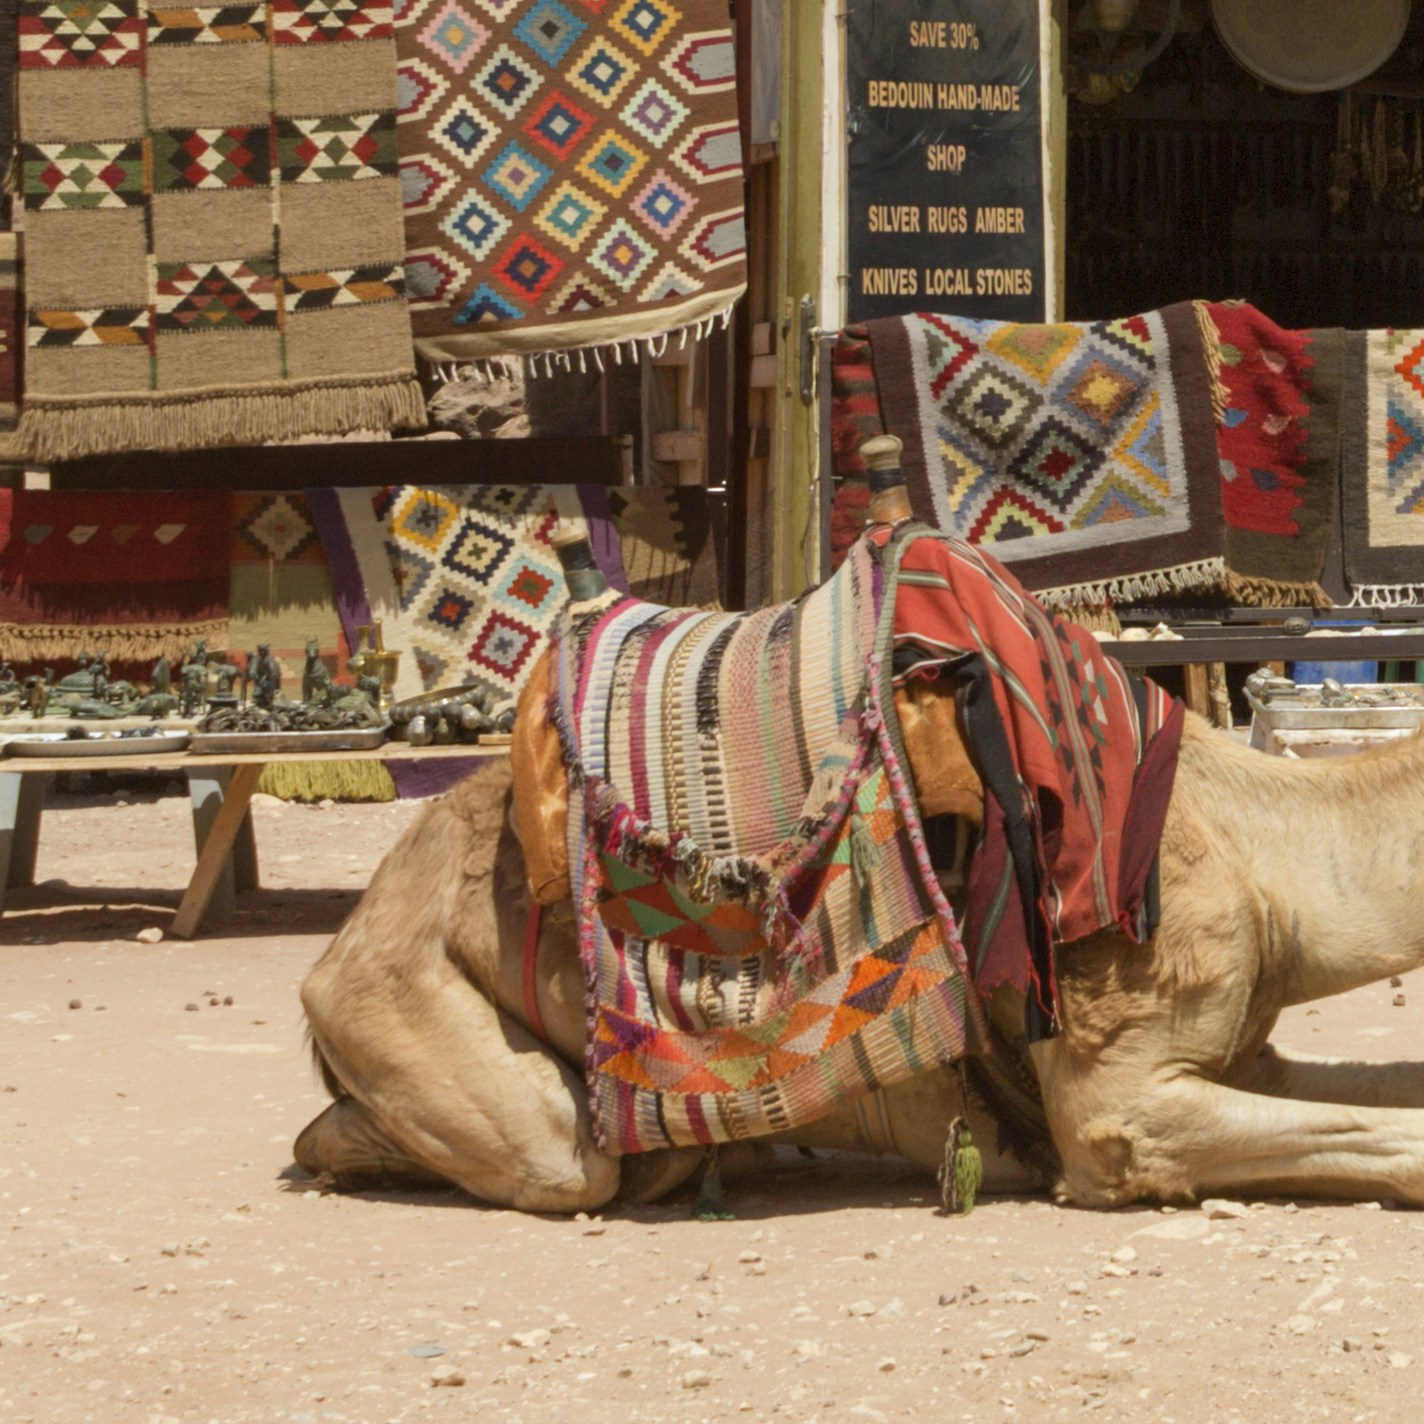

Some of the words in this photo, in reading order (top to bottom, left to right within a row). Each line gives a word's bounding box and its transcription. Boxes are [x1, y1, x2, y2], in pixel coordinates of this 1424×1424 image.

[910, 21, 946, 48] SAVE
[950, 23, 979, 51] 30%
[868, 80, 933, 109] BEDOUIN
[937, 83, 1020, 111] HAND-MADE
[927, 144, 966, 171] SHOP
[868, 205, 920, 233] SILVER
[928, 206, 967, 233] RUGS
[975, 207, 1025, 234] AMBER
[862, 268, 917, 295] KNIVES
[925, 268, 972, 295] LOCAL
[976, 268, 1032, 295] STONES
